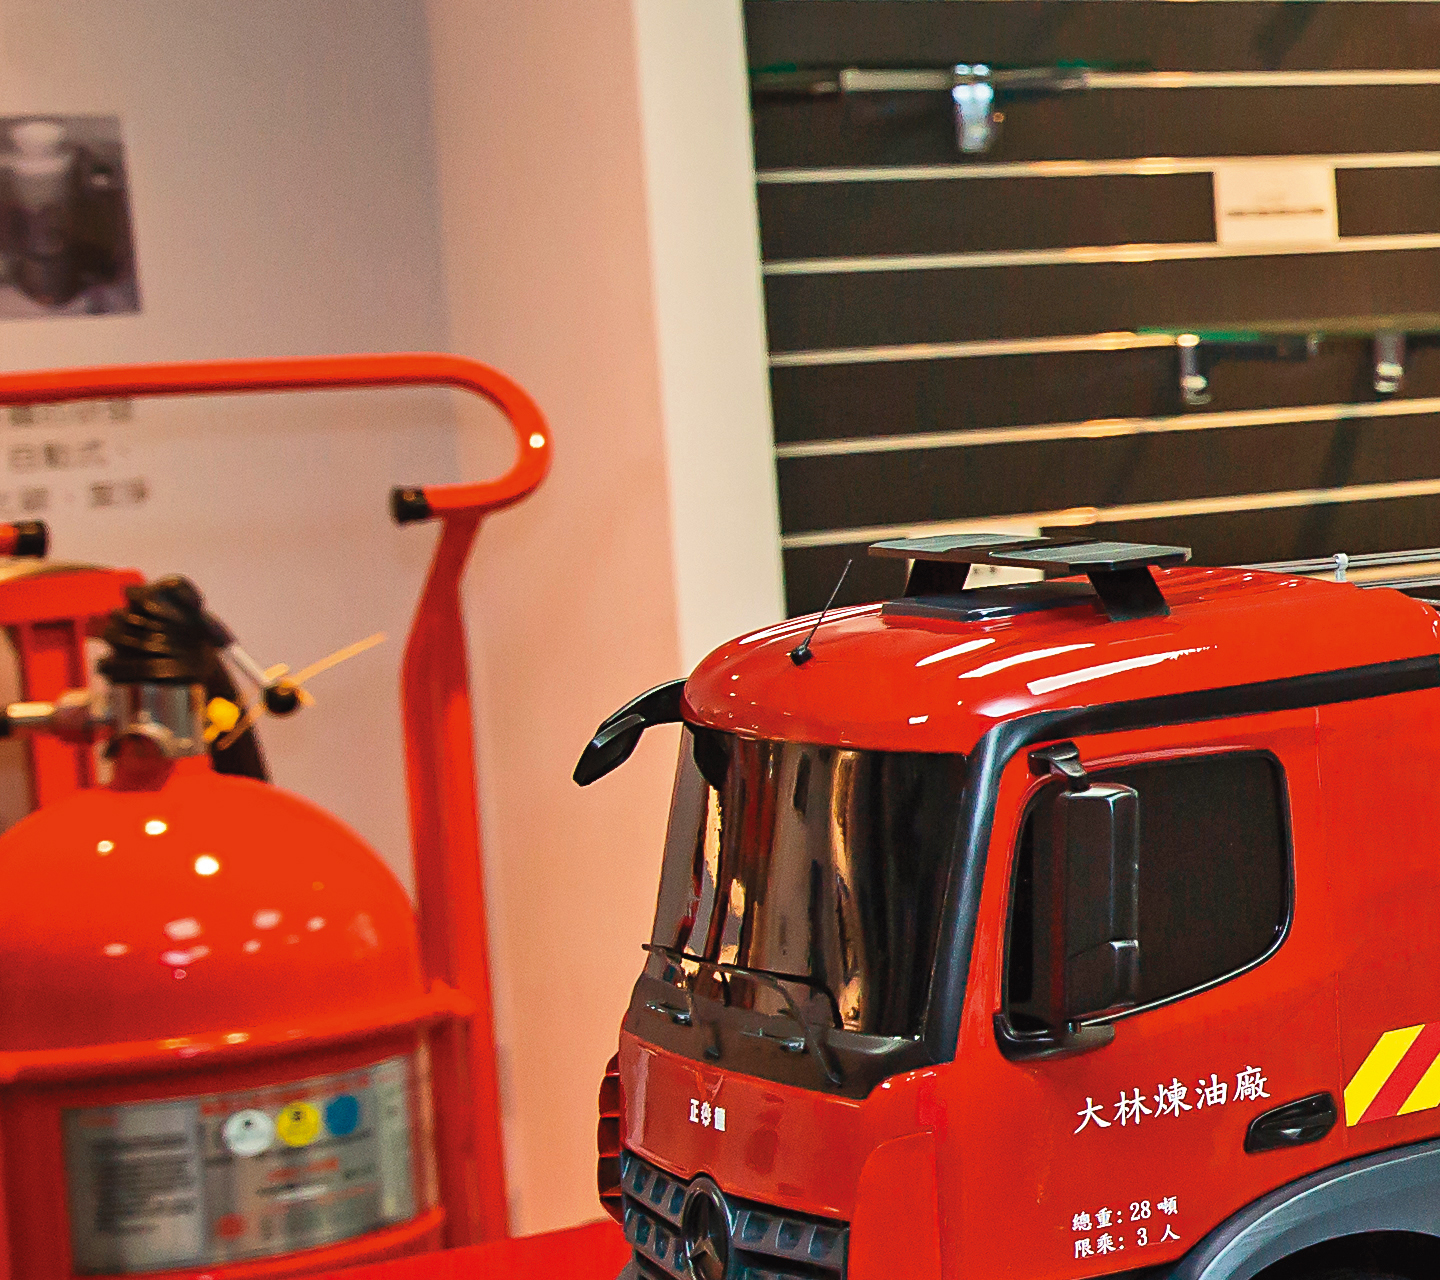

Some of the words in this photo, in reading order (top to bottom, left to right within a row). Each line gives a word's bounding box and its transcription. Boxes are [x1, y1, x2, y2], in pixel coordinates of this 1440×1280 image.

[1072, 1064, 1271, 1135] 大林煉油廠
[1129, 1200, 1152, 1222] 28
[1136, 1227, 1148, 1247] 3
[1160, 1223, 1181, 1243] 人
